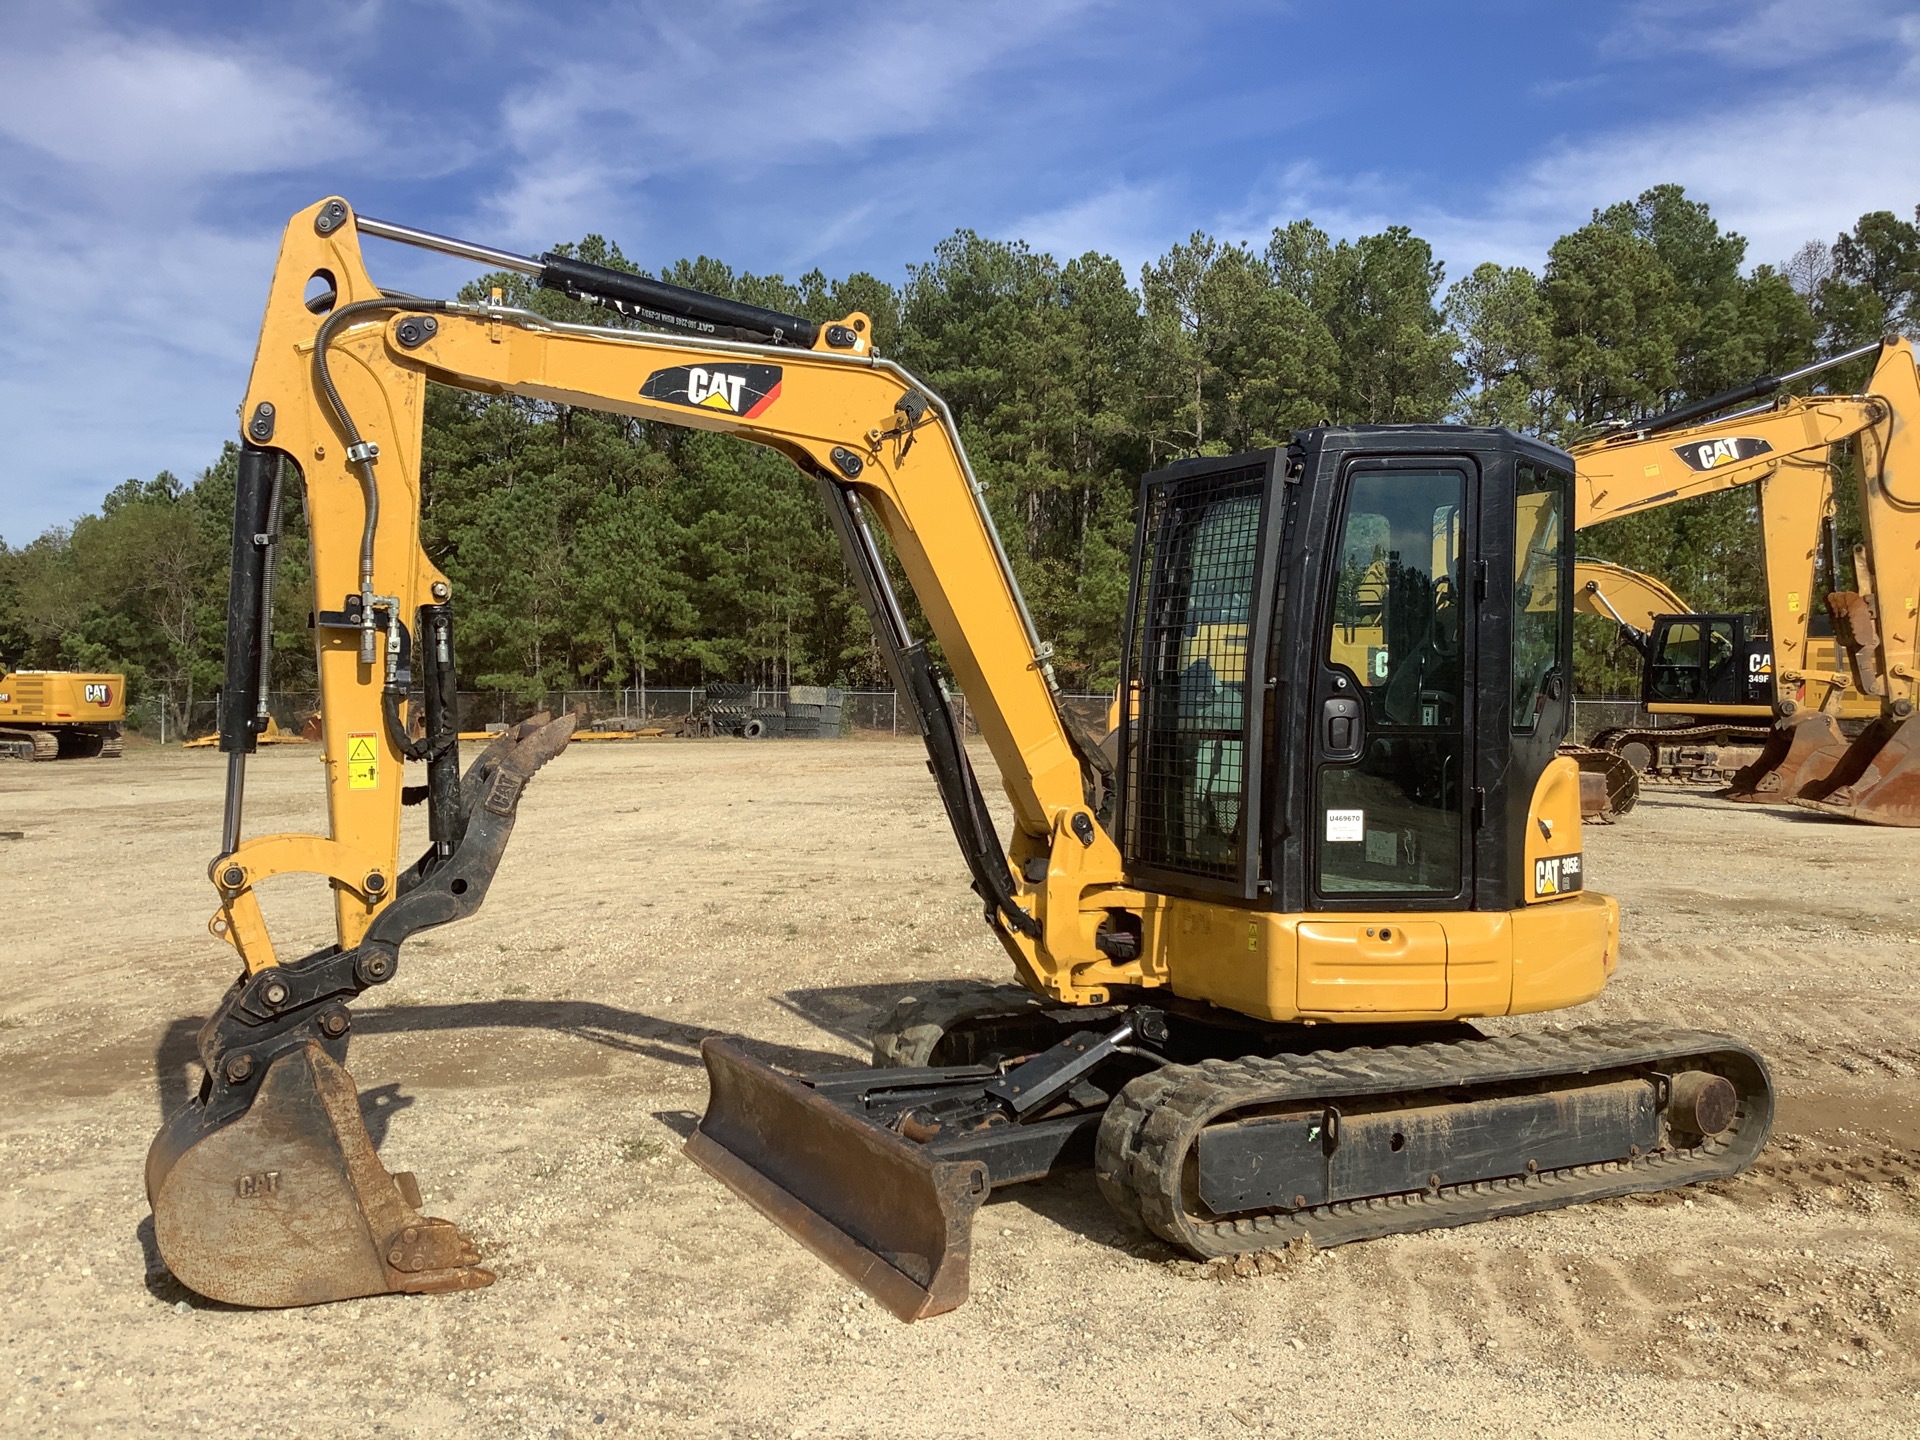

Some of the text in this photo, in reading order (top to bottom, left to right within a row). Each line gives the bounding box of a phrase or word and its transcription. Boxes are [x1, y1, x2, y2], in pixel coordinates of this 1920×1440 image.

[697, 322, 715, 333] CAT
[688, 367, 746, 413] CAT
[1698, 437, 1741, 470] CAT
[1749, 653, 1772, 673] CA
[1748, 674, 1769, 683] 349F
[85, 684, 107, 702] CAT
[491, 773, 519, 809] CAT
[1536, 859, 1560, 894] CAT
[238, 1171, 281, 1199] CAT
